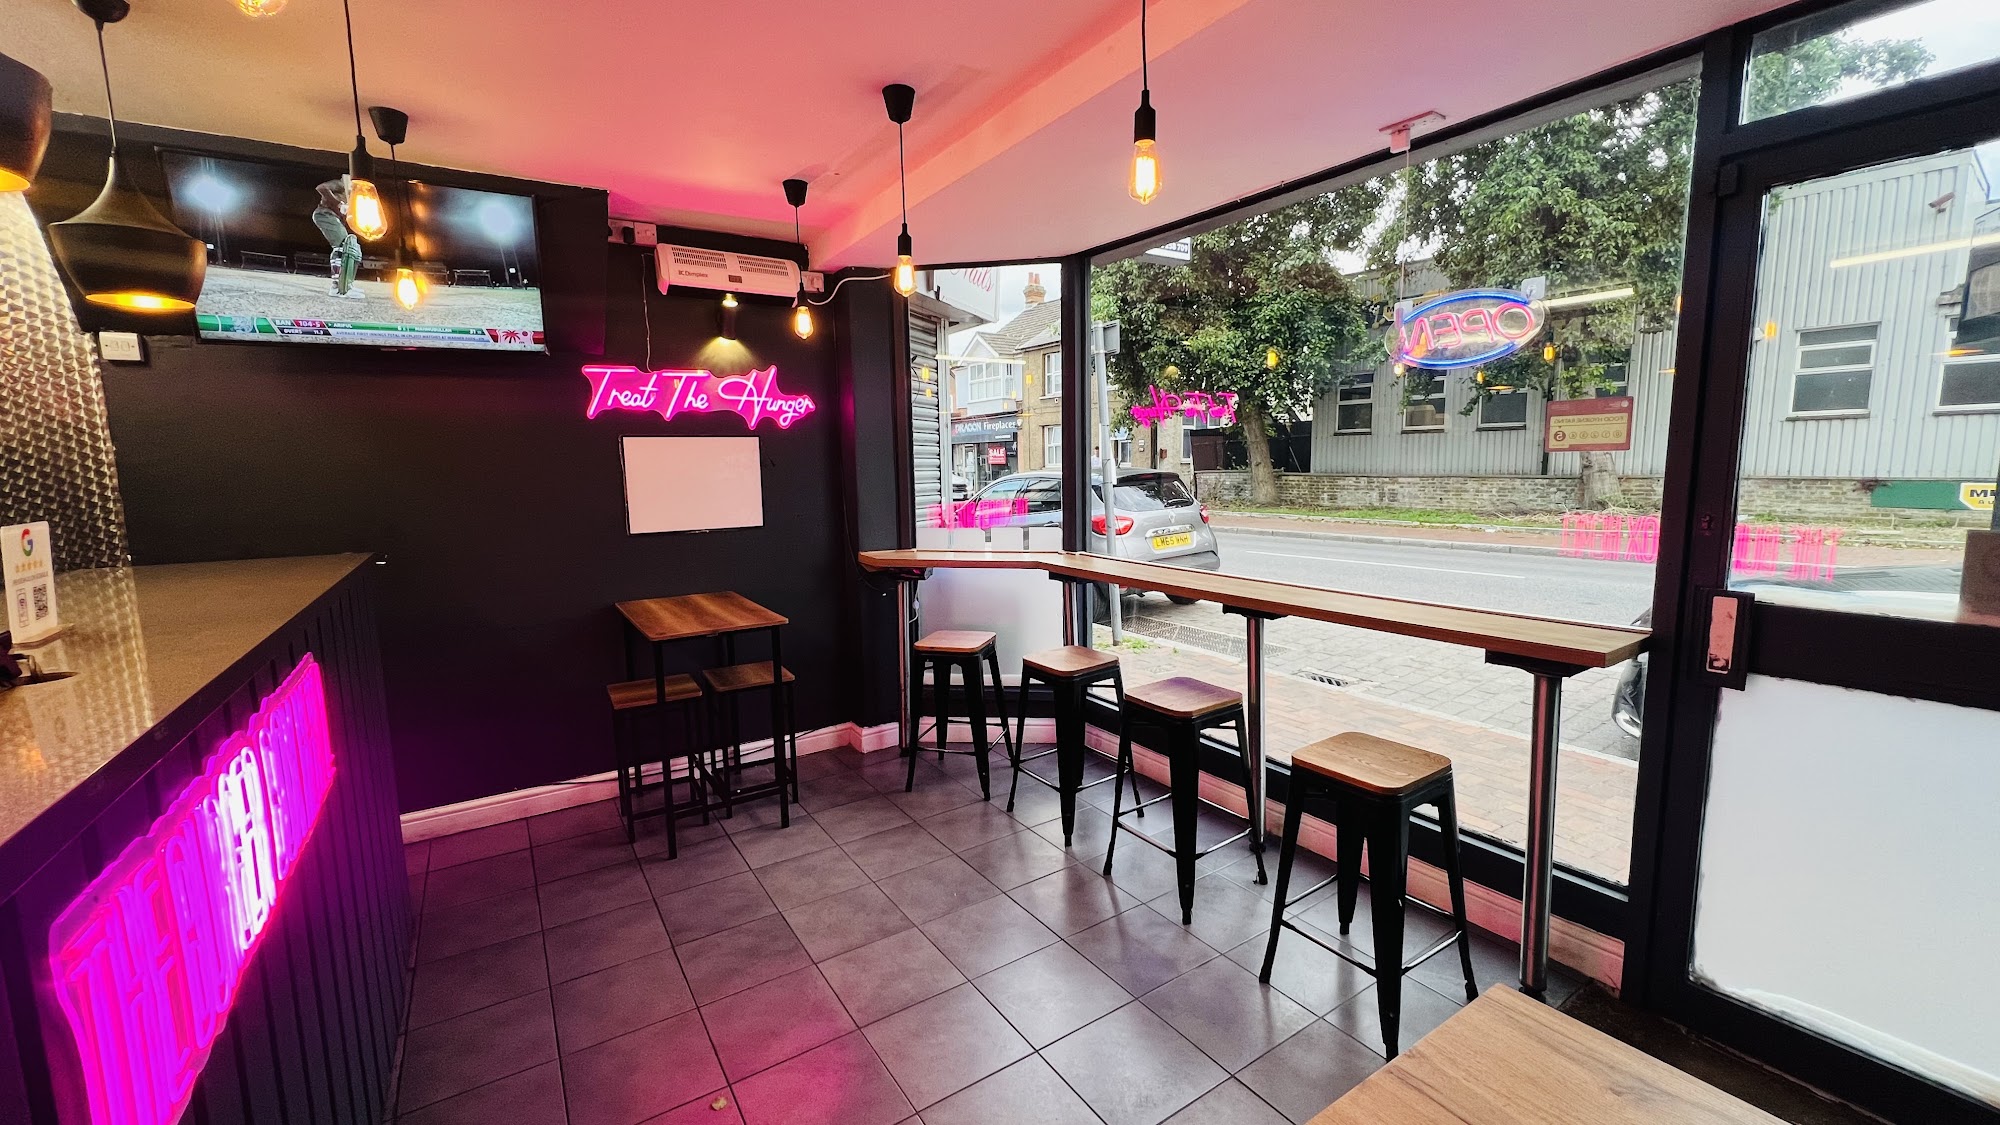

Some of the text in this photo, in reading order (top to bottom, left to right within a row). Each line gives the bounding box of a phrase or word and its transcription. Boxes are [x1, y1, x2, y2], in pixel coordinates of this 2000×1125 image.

[275, 319, 292, 327] BAN
[298, 320, 321, 328] 104-5
[583, 365, 815, 427] Treat The Hunger
[983, 420, 1016, 431] Fireplaces
